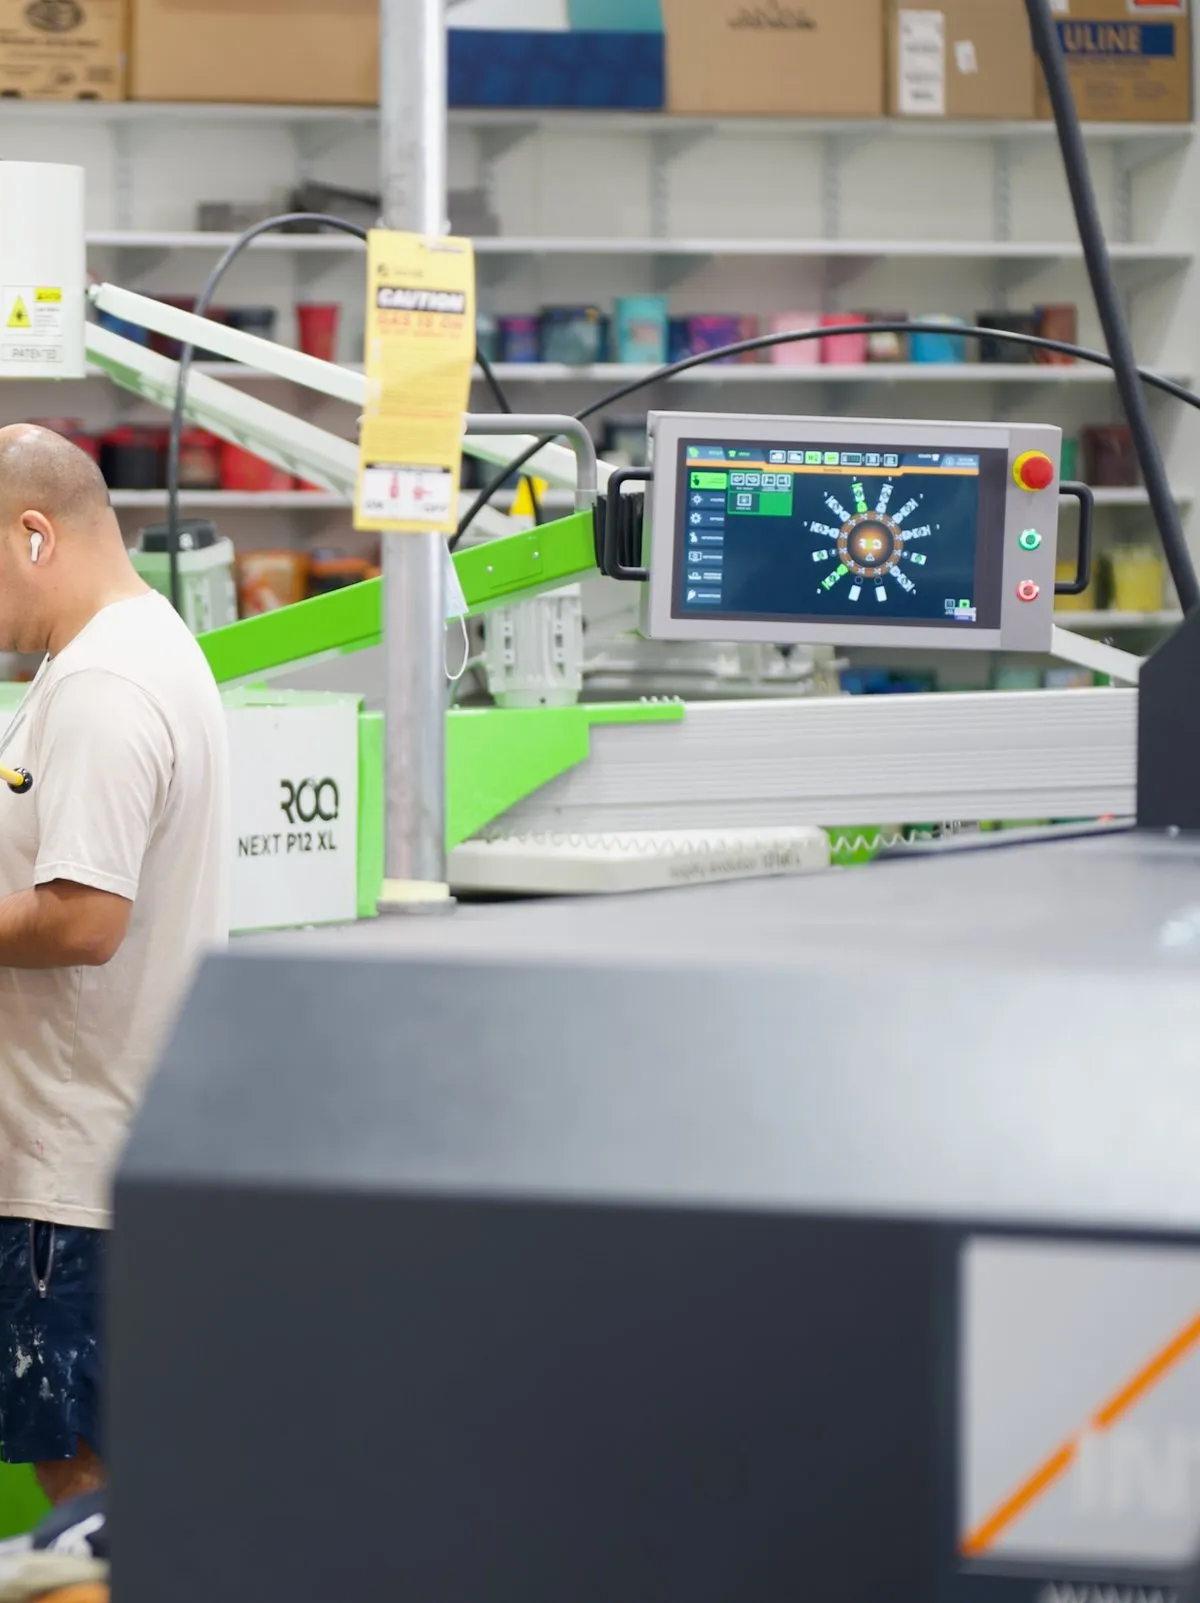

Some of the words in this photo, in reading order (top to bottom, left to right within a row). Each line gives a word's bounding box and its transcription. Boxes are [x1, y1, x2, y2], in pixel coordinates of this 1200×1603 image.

[1063, 24, 1142, 53] ULINE
[378, 287, 464, 313] CAUTION
[280, 778, 338, 824] ROQ
[238, 833, 281, 857] NEXT
[286, 831, 312, 854] P12
[317, 829, 337, 851] XL
[1072, 1426, 1200, 1512] IN
